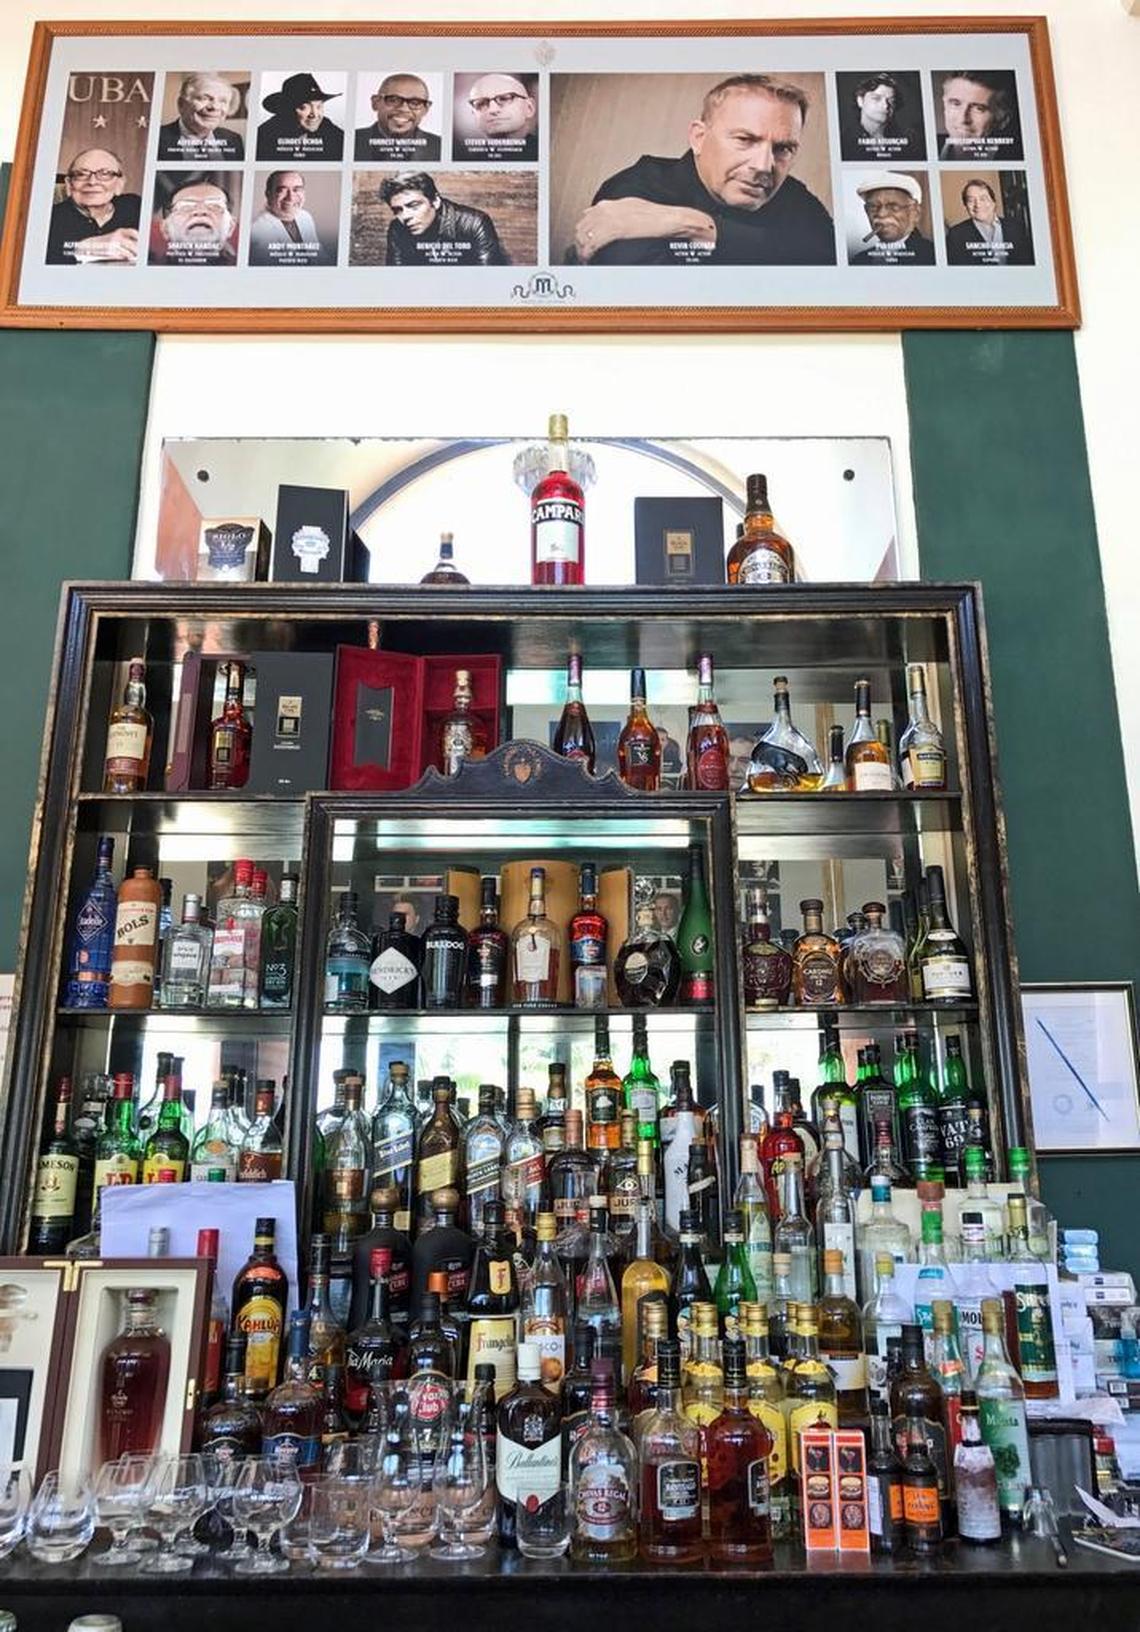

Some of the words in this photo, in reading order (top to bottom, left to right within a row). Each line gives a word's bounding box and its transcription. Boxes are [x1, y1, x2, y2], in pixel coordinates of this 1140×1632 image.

[531, 504, 583, 524] CAMPAR
[117, 914, 149, 939] BOLS
[426, 941, 464, 950] BULLDOG
[941, 1119, 968, 1136] VAT
[945, 1134, 964, 1148] 69
[423, 1428, 432, 1441] 7
[578, 1488, 602, 1498] CHIVAS
[604, 1488, 626, 1500] REGAL
